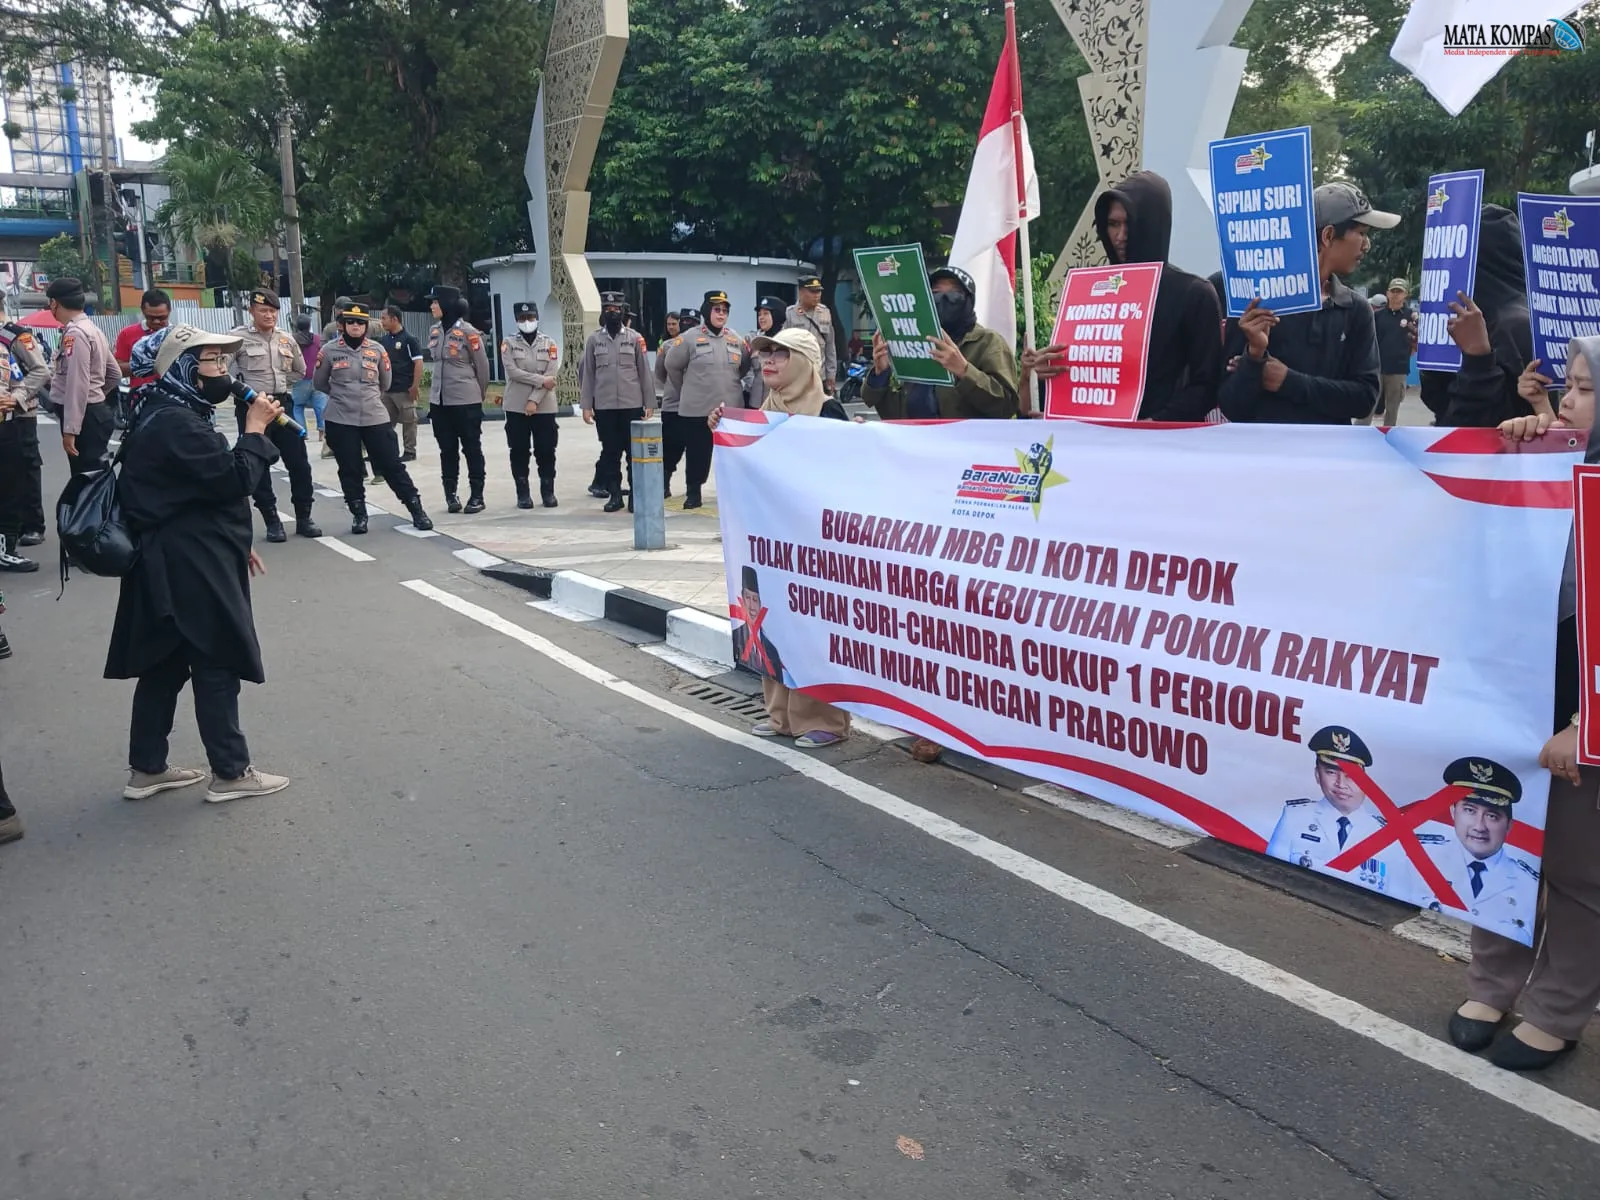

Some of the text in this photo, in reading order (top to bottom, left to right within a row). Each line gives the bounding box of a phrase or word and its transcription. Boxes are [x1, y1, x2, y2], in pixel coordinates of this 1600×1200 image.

[1218, 184, 1302, 214] SUPIAN SURI
[1228, 216, 1291, 243] CHANDRA
[1532, 243, 1600, 269] ANGGOTA DPRD
[1229, 273, 1309, 300] OMON-OMON
[1538, 269, 1599, 295] KOTA DEPOK,
[880, 294, 916, 313] STOP
[1065, 302, 1143, 321] KOMISI 8%
[1532, 291, 1557, 314] CAMAT
[1558, 296, 1581, 316] DAN
[891, 317, 921, 336] PHK
[1074, 324, 1125, 341] UNTUK
[1068, 345, 1123, 363] DRIVER
[1070, 366, 1120, 385] ONLINE
[961, 469, 1040, 486] BaraNusa
[952, 508, 996, 519] KOTA DEPOK
[821, 508, 1238, 606] BUBARKAN MBG DI KOTA DEPOK
[748, 534, 1440, 705] TOLAK KENAIKAN HARGA KEBUTUHAN POKOK RAKYAT
[788, 582, 1304, 744] SUPIAN SURI-CHANDRA CUKUP 1 PERIODE
[829, 633, 1208, 775] KAMI MUAK DENGAN PRABOWO
